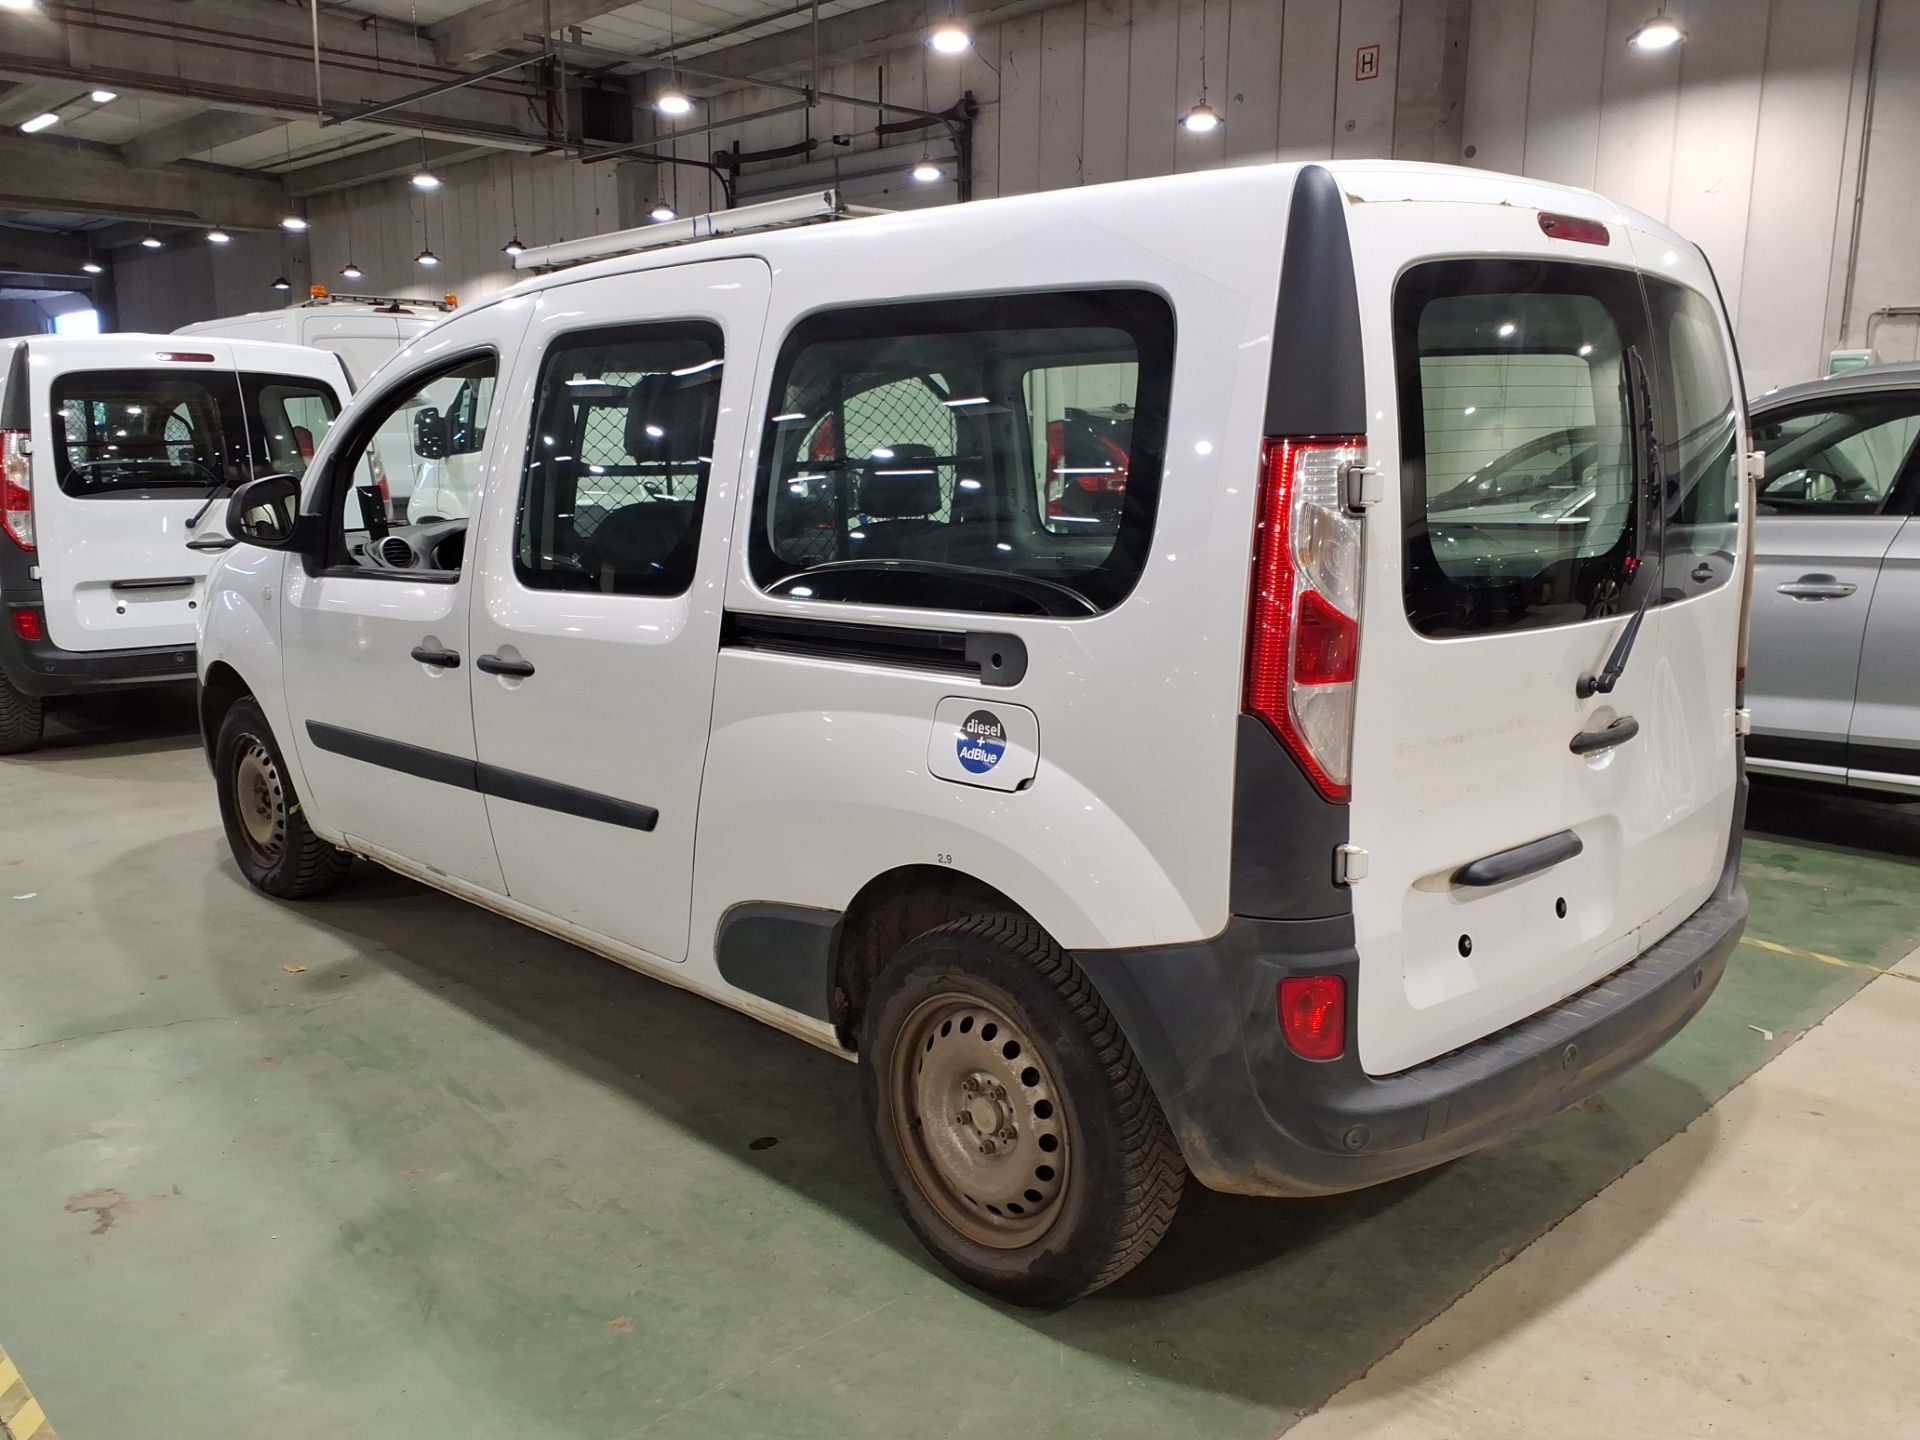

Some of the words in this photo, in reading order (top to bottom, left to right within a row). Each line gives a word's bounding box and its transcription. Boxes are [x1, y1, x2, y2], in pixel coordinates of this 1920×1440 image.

[1361, 52, 1374, 73] H
[966, 719, 1001, 737] diesel
[976, 736, 985, 747] +
[960, 746, 997, 763] AdBlue
